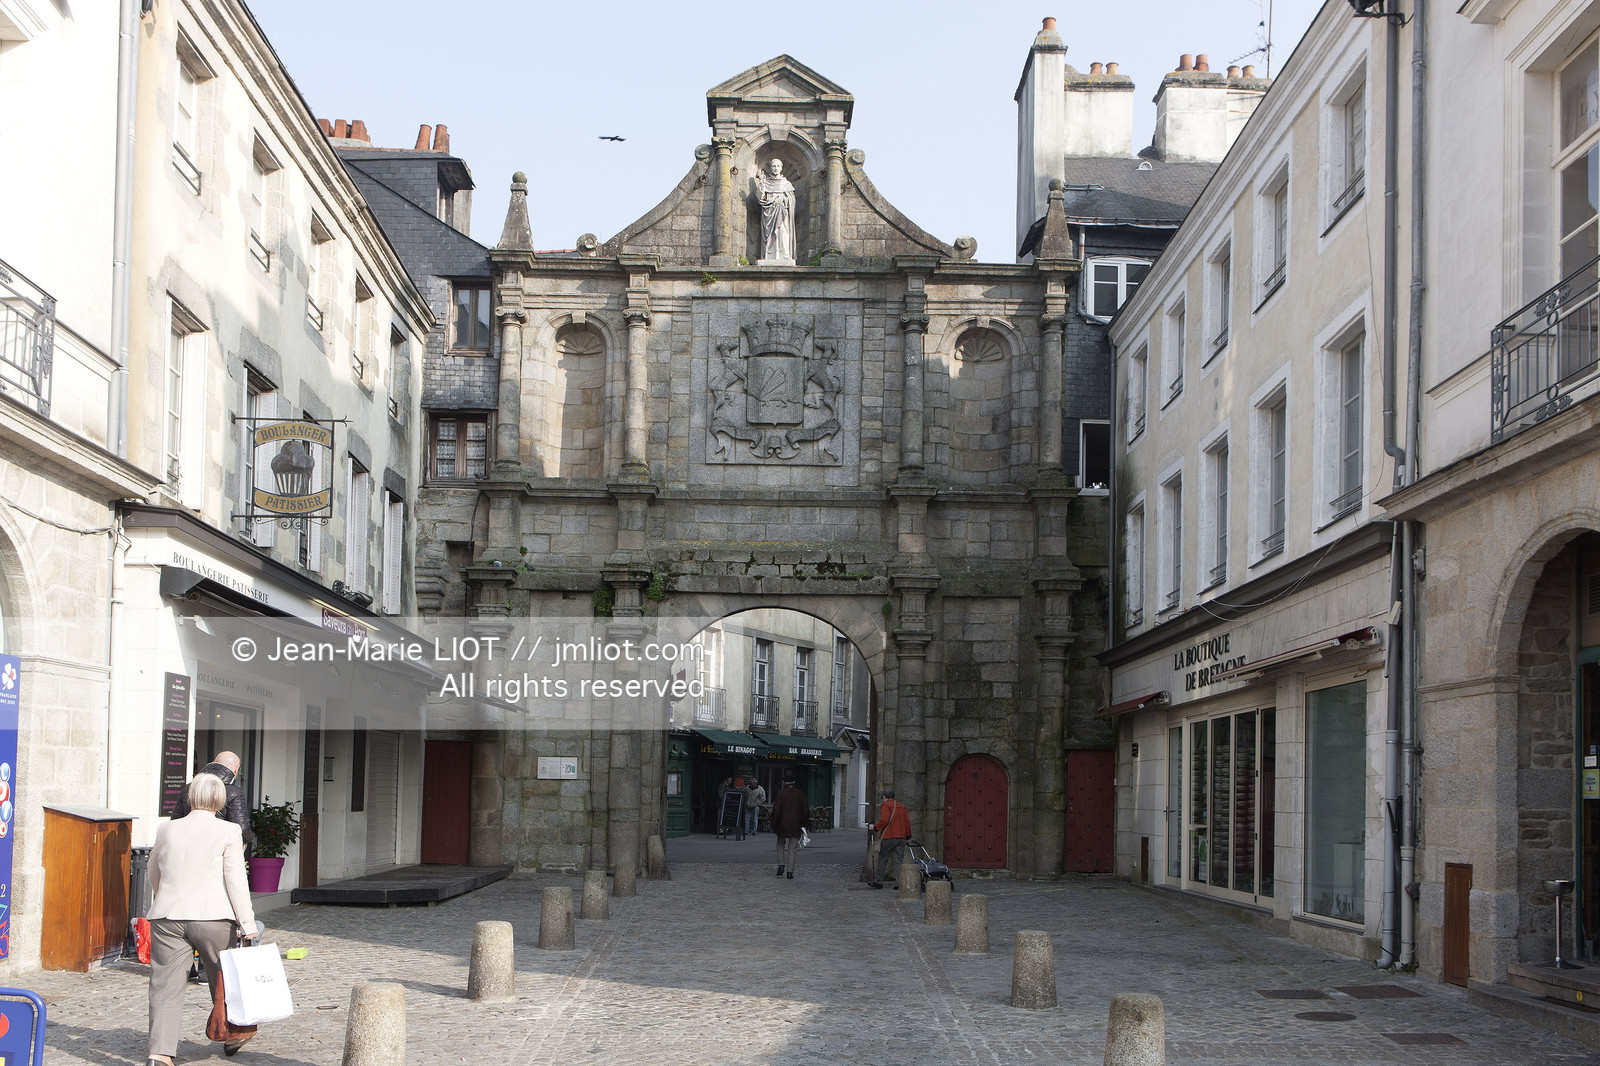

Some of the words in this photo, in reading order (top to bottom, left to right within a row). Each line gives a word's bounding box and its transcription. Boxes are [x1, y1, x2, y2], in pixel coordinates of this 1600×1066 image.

[260, 425, 327, 442] BOULANGER
[264, 495, 323, 511] PATISSIER
[173, 551, 231, 589] BOULANGERIE
[232, 578, 270, 604] PATISSERIE
[323, 609, 347, 634] Saveurs
[1174, 651, 1185, 671] LA
[1186, 633, 1230, 667] BOUTIQUE
[1185, 671, 1197, 692] DE
[727, 745, 735, 753] LE
